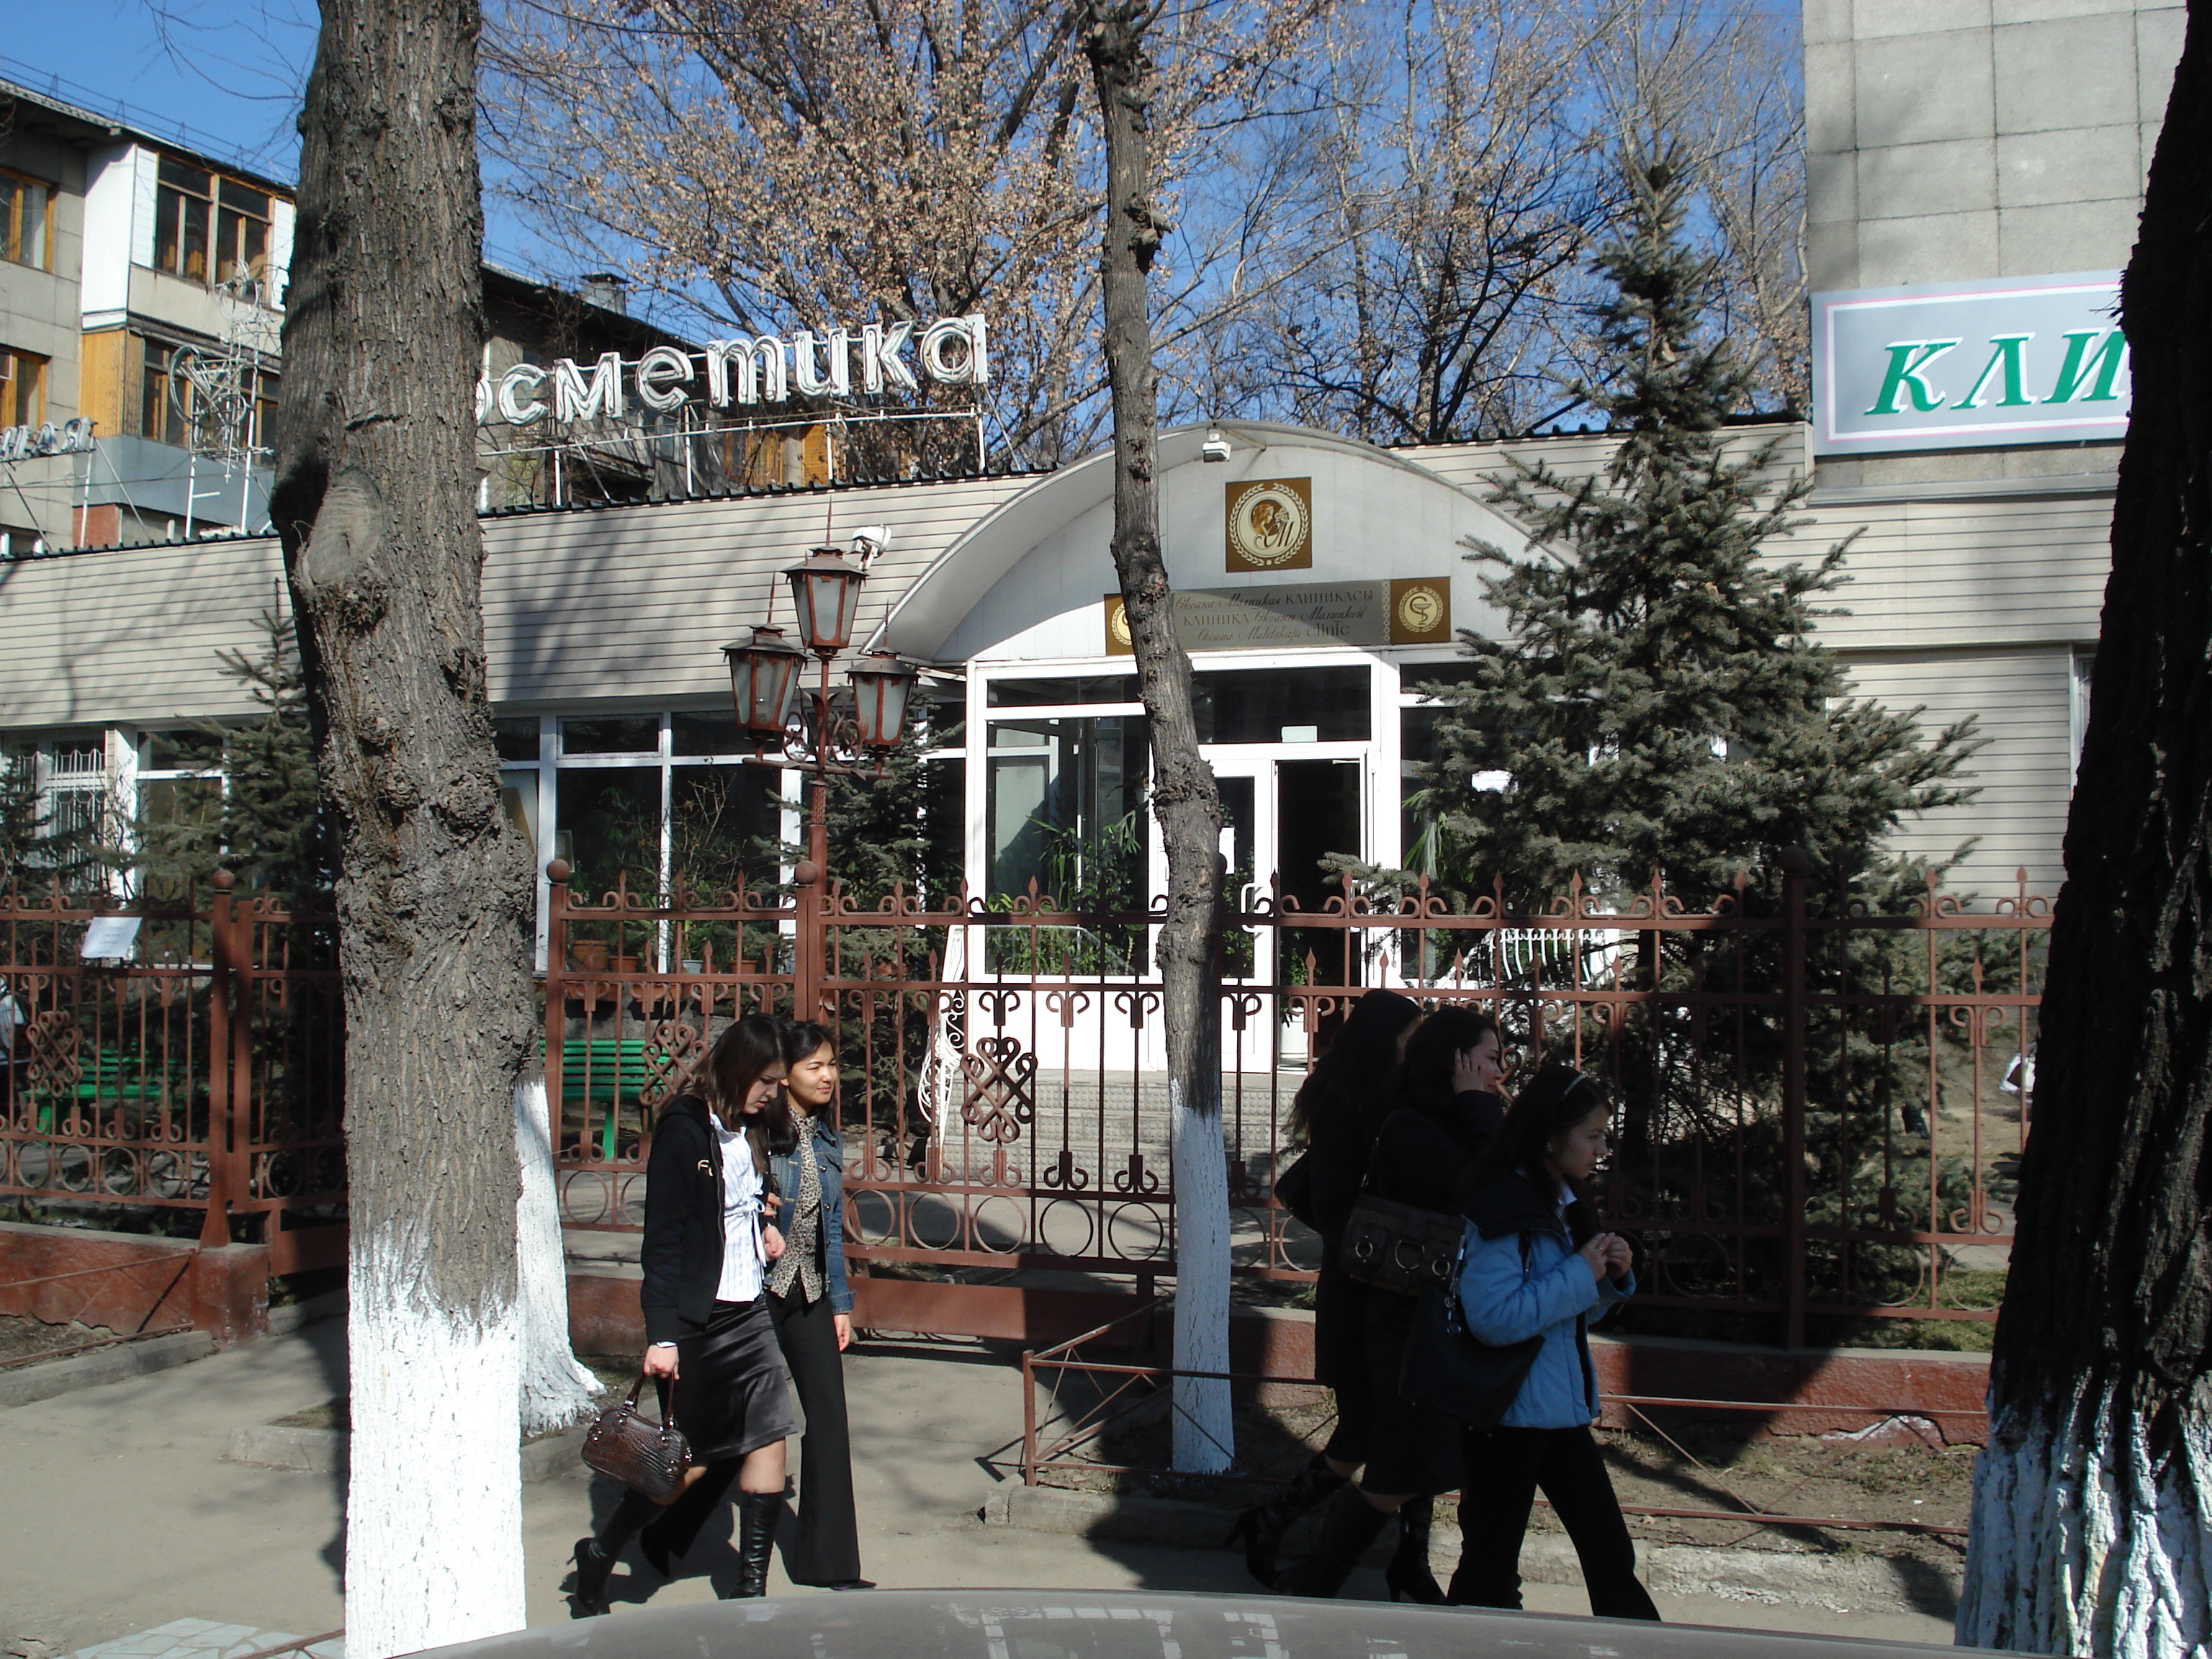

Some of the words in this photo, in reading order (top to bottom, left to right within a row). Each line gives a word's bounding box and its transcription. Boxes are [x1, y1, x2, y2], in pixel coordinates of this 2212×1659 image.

[0, 415, 92, 462] НАЯ
[1286, 590, 1373, 605] КЛИНИКАСЫ
[1183, 613, 1250, 626] КЛИНИКА
